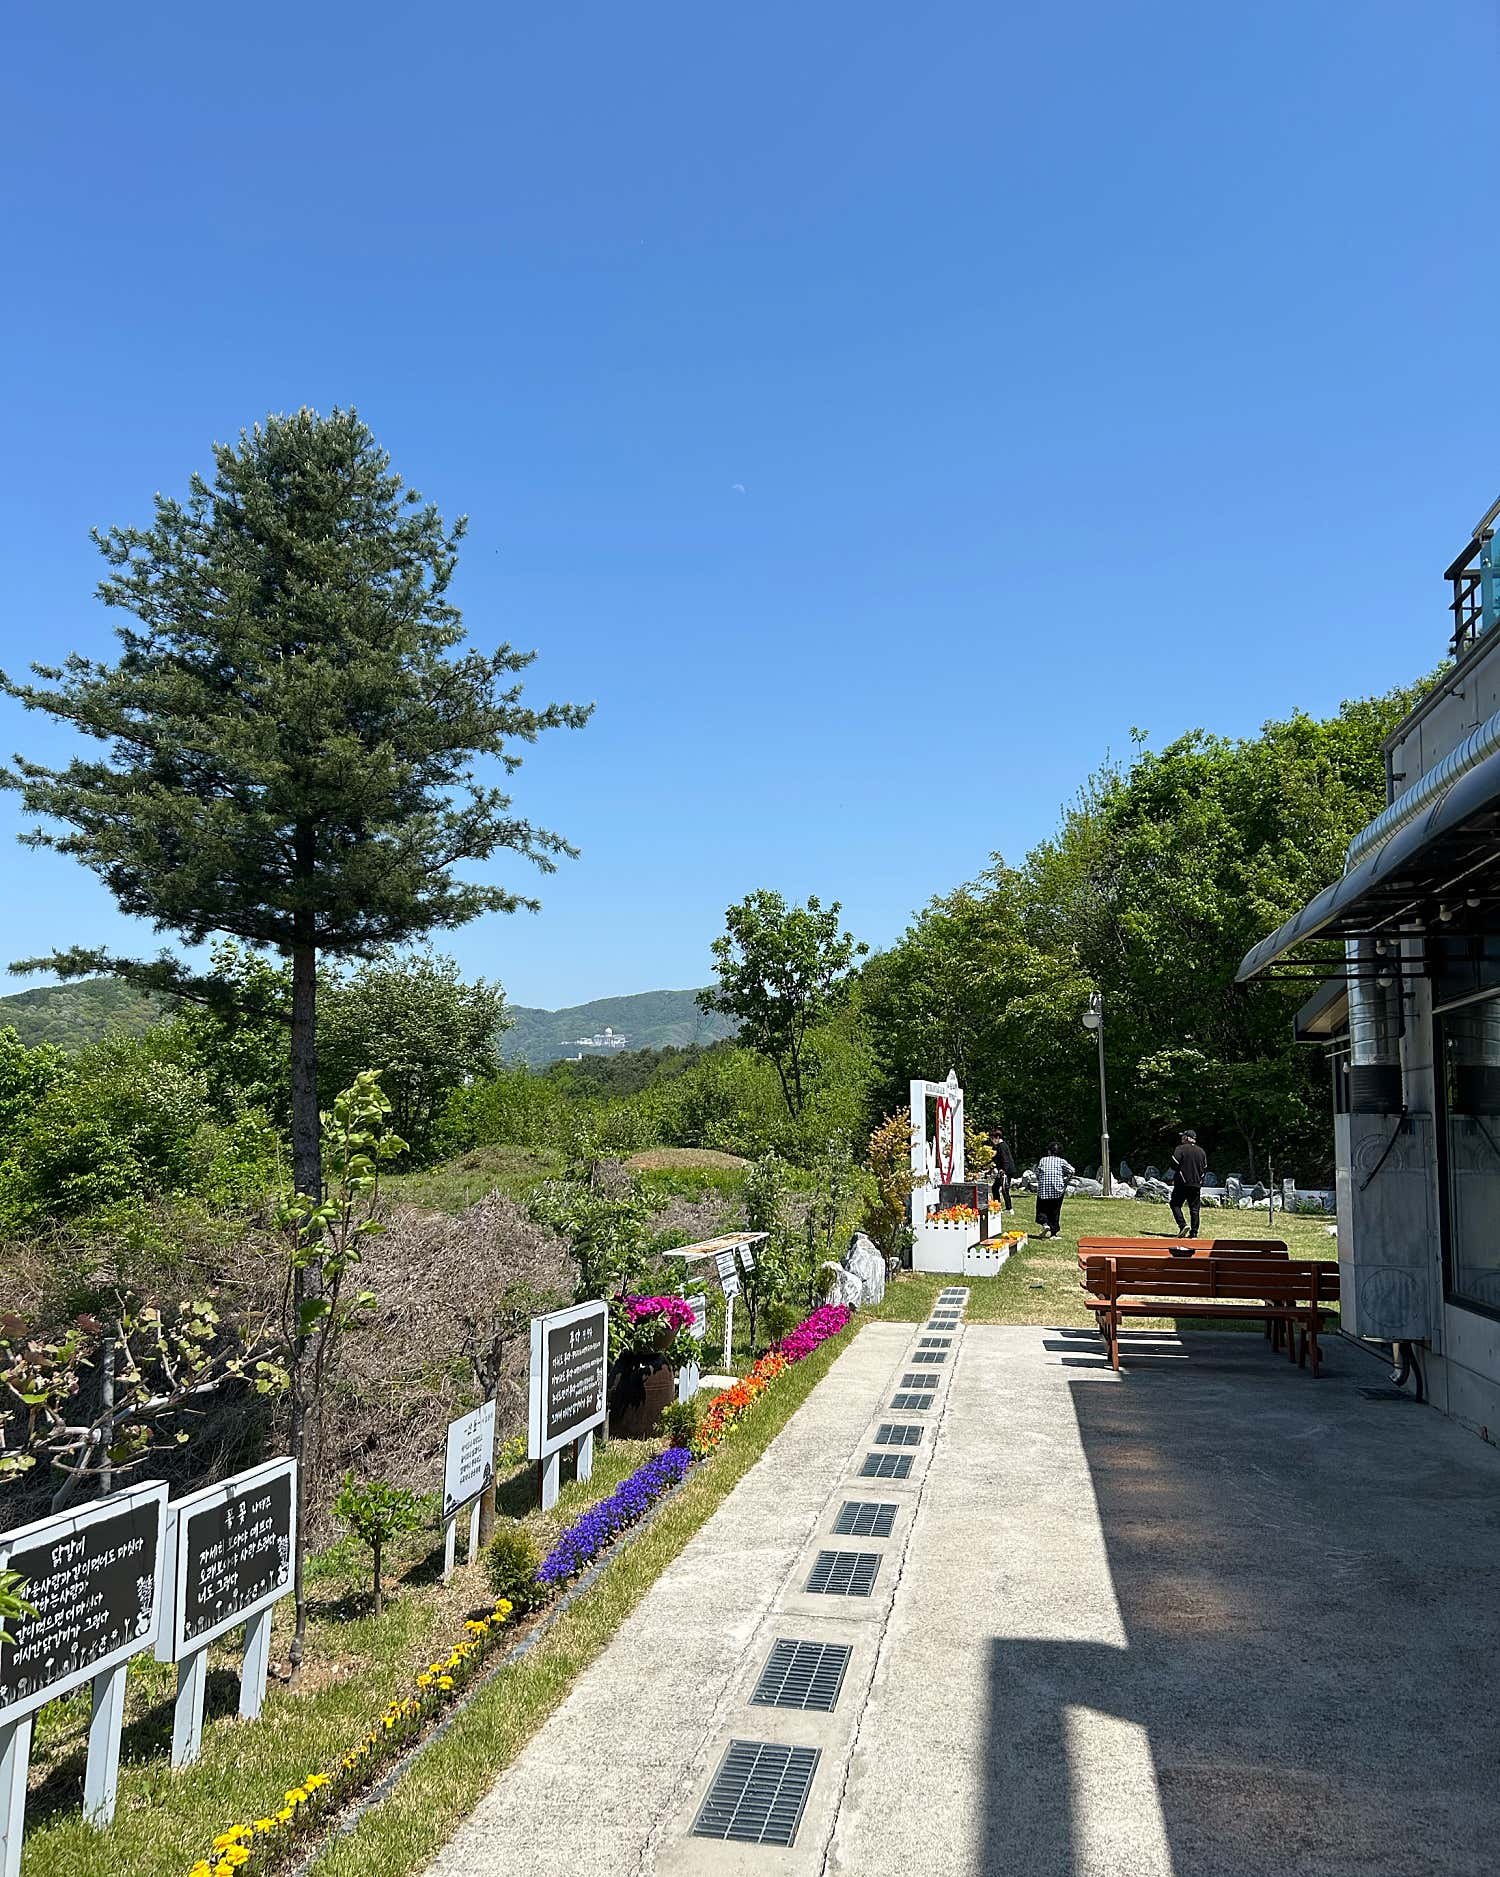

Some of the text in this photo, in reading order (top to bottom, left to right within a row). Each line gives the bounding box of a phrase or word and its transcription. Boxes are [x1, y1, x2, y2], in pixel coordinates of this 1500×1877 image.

[252, 1495, 272, 1513] 나태주
[199, 1538, 225, 1565] 자세히
[226, 1529, 249, 1551] 보아야
[197, 1571, 239, 1604] 너도 그렇다
